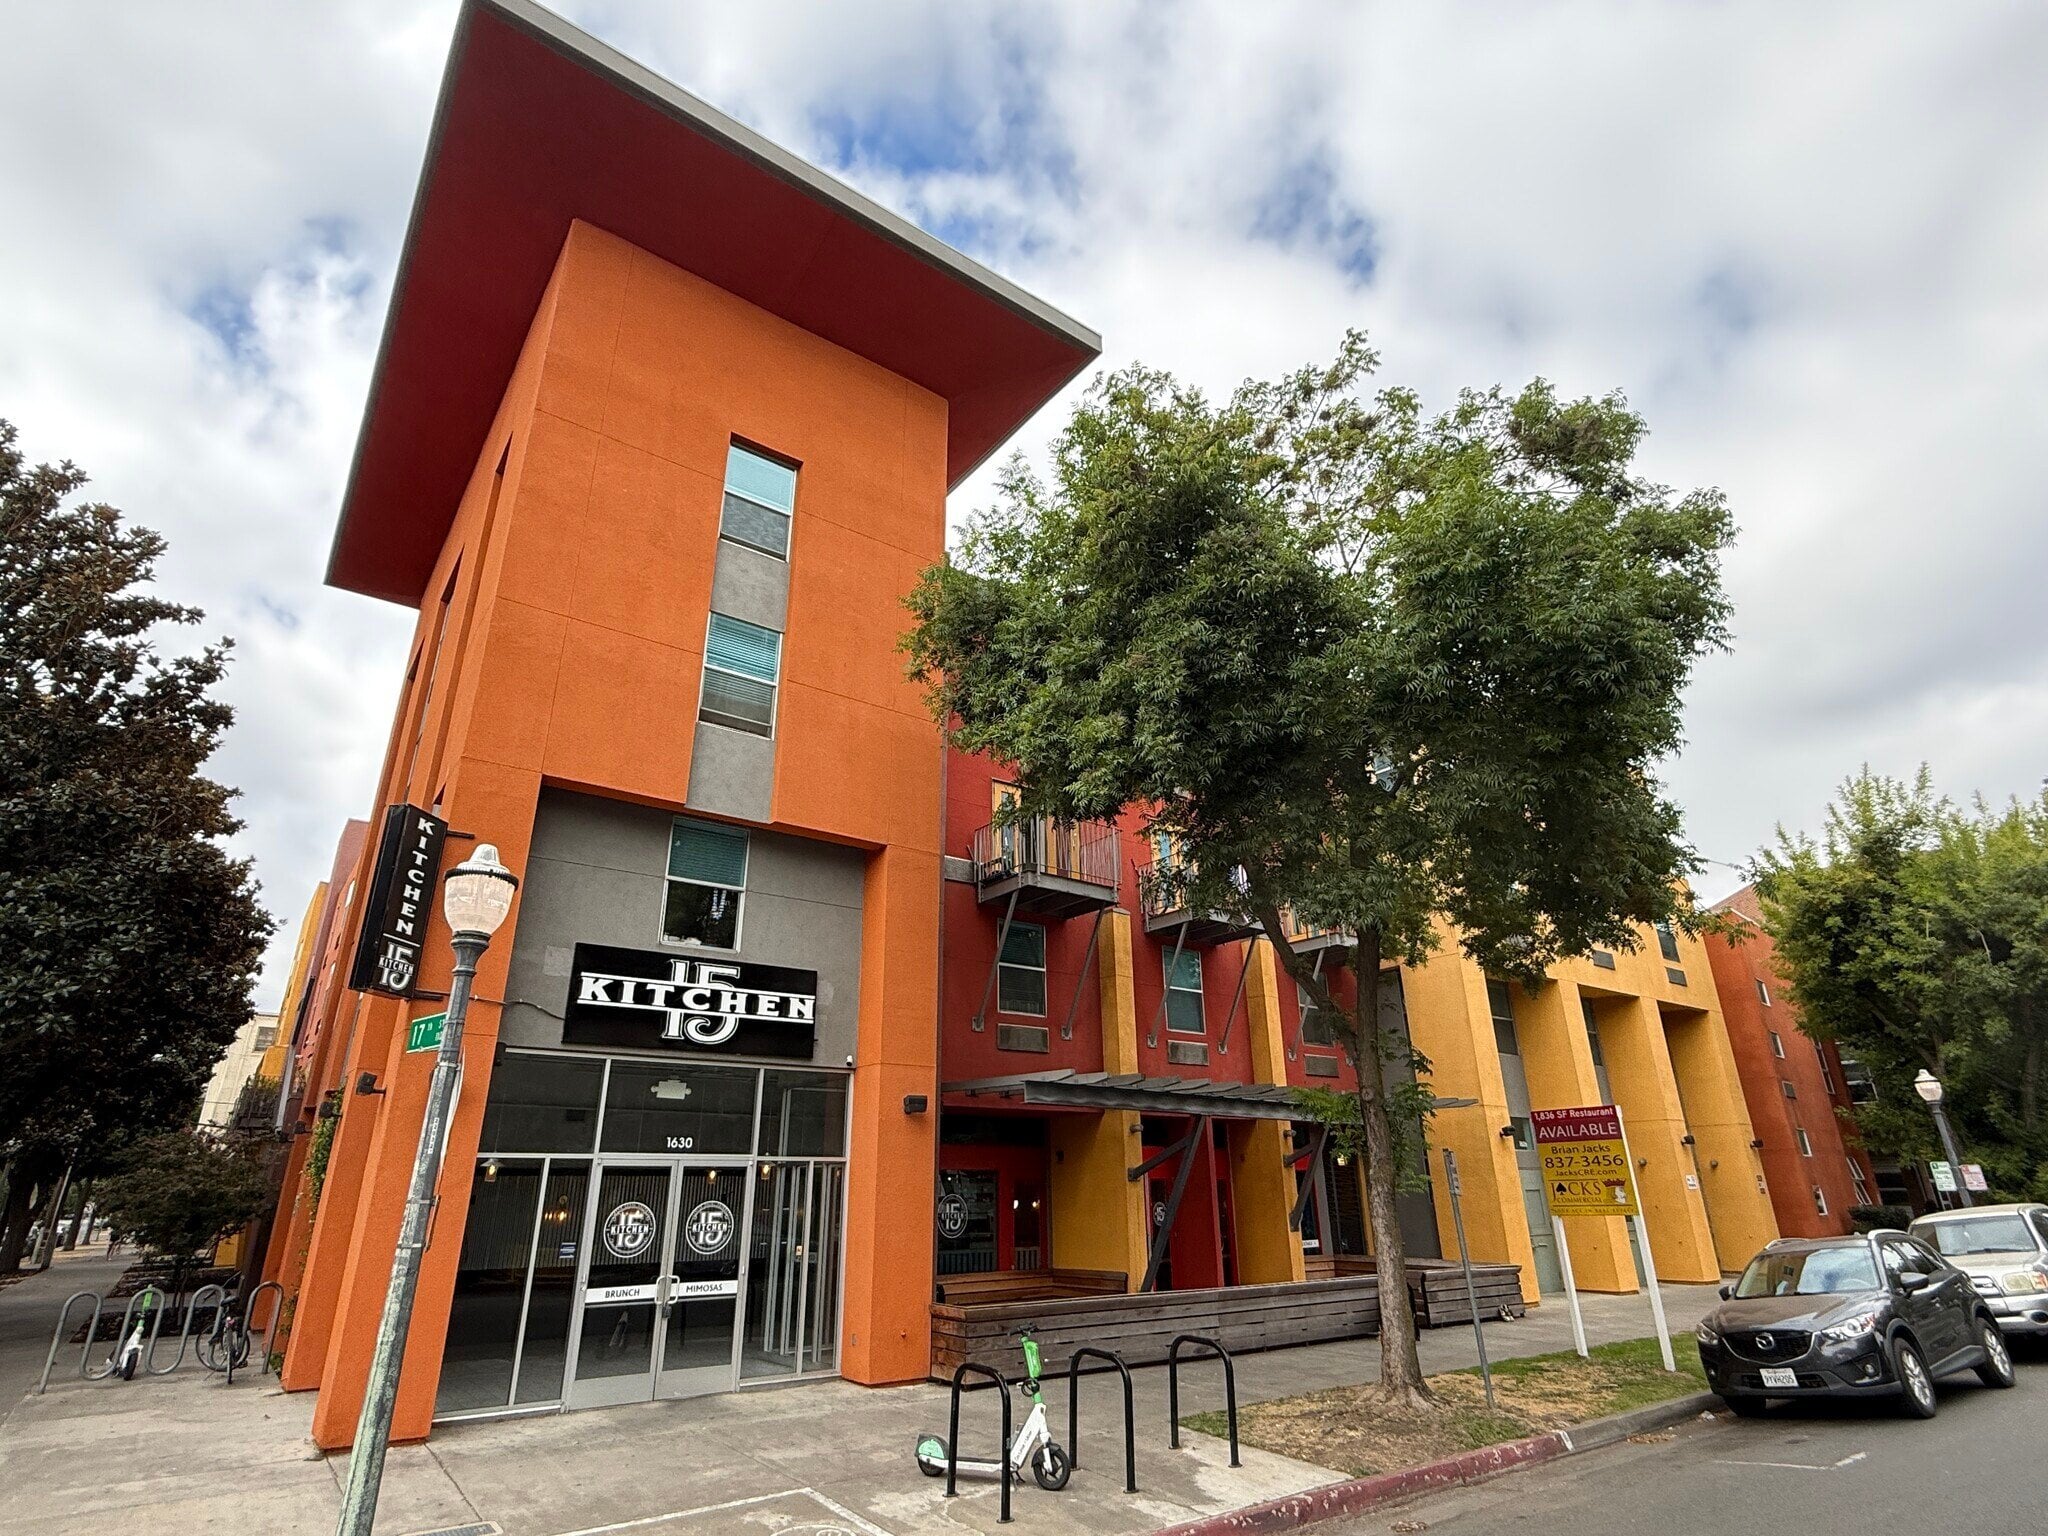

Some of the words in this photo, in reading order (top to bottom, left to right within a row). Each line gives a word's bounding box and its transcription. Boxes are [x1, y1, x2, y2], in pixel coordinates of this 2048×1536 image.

[395, 816, 435, 936] KITCHEN
[378, 955, 414, 976] KITCHEN
[578, 976, 816, 1020] KITCHEN
[661, 958, 741, 1045] 15
[1534, 1111, 1555, 1122] 1,836
[1556, 1109, 1568, 1119] SF
[1569, 1107, 1614, 1118] Restaurant
[1539, 1122, 1618, 1139] AVAILABLE
[666, 1136, 693, 1149] 1630
[1551, 1145, 1579, 1154] Brian
[1581, 1143, 1611, 1153] Jacks
[1544, 1154, 1624, 1169] 837-3456
[1555, 1168, 1617, 1176] JacksCRE.com
[610, 1224, 650, 1236] KITCHEN
[692, 1222, 728, 1233] KITCHEN
[604, 1288, 640, 1299] BRUNCH
[685, 1283, 723, 1293] MIMOSAS
